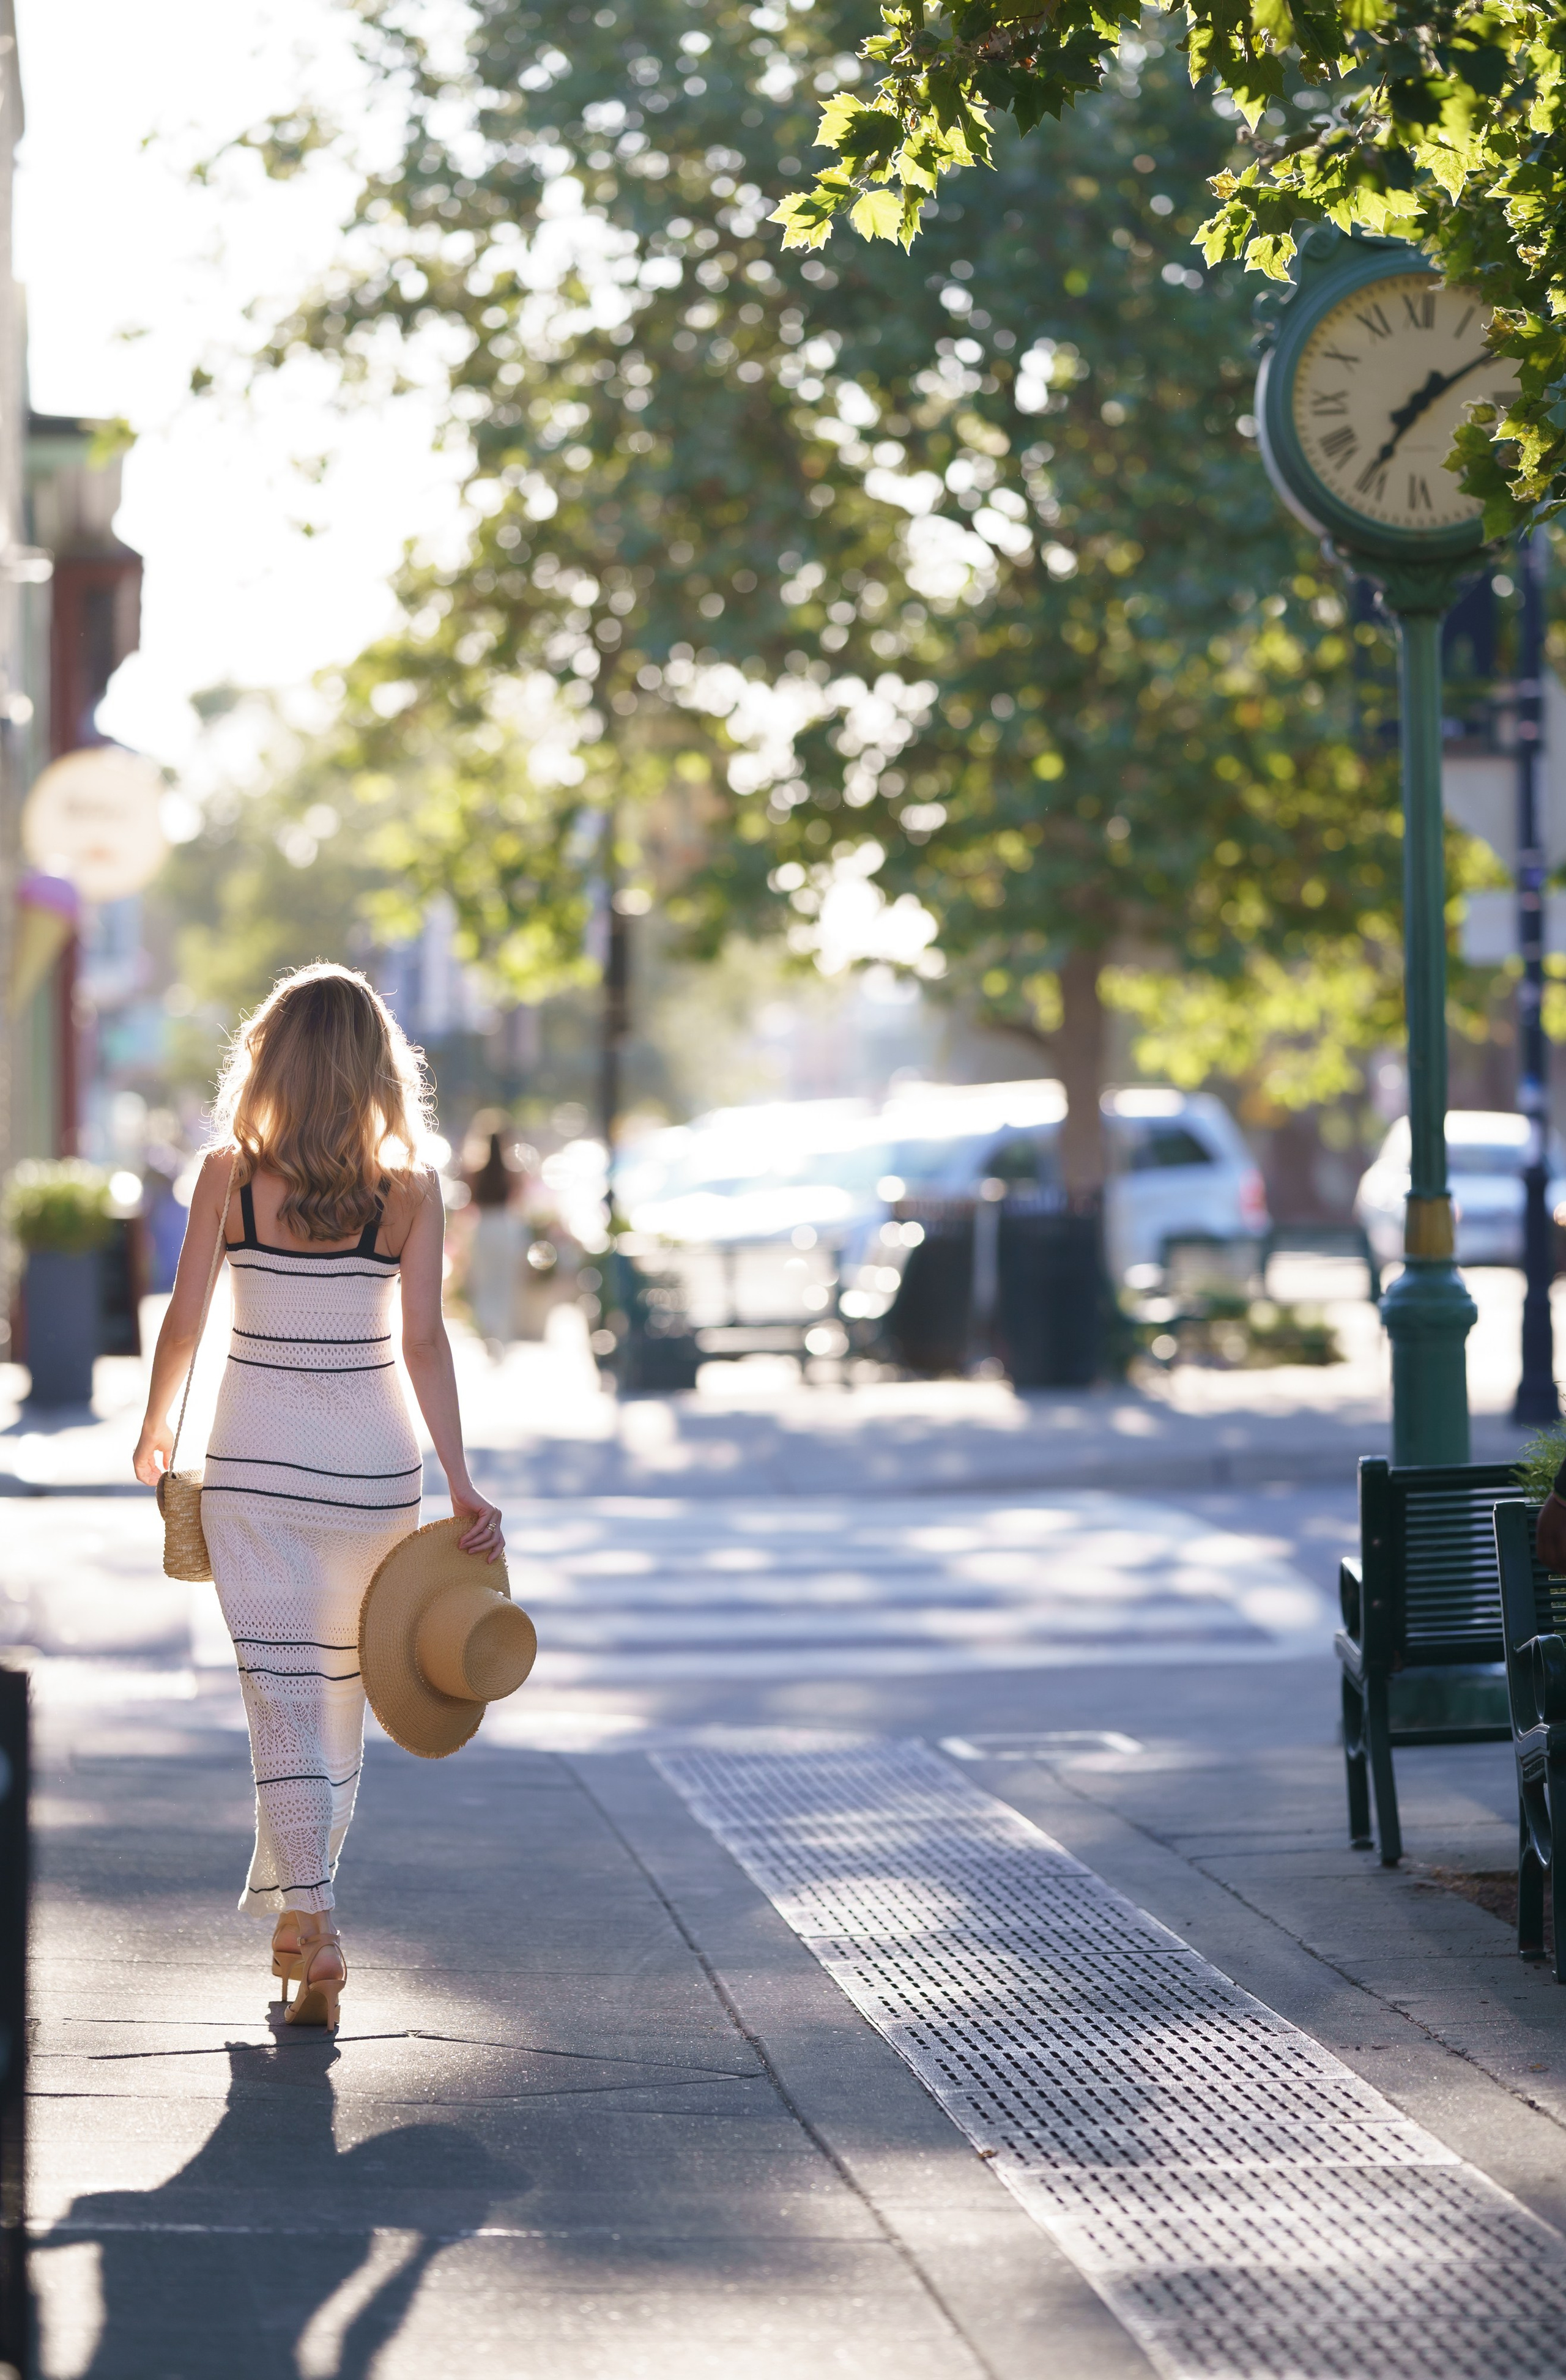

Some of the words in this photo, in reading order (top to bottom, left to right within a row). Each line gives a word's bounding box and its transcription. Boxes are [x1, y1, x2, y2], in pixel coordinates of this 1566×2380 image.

[1354, 302, 1392, 345] XI
[1403, 292, 1435, 330] XII
[1455, 306, 1475, 339] I
[1322, 341, 1360, 374] X
[1311, 390, 1349, 416] IX
[1408, 473, 1433, 510] VI
